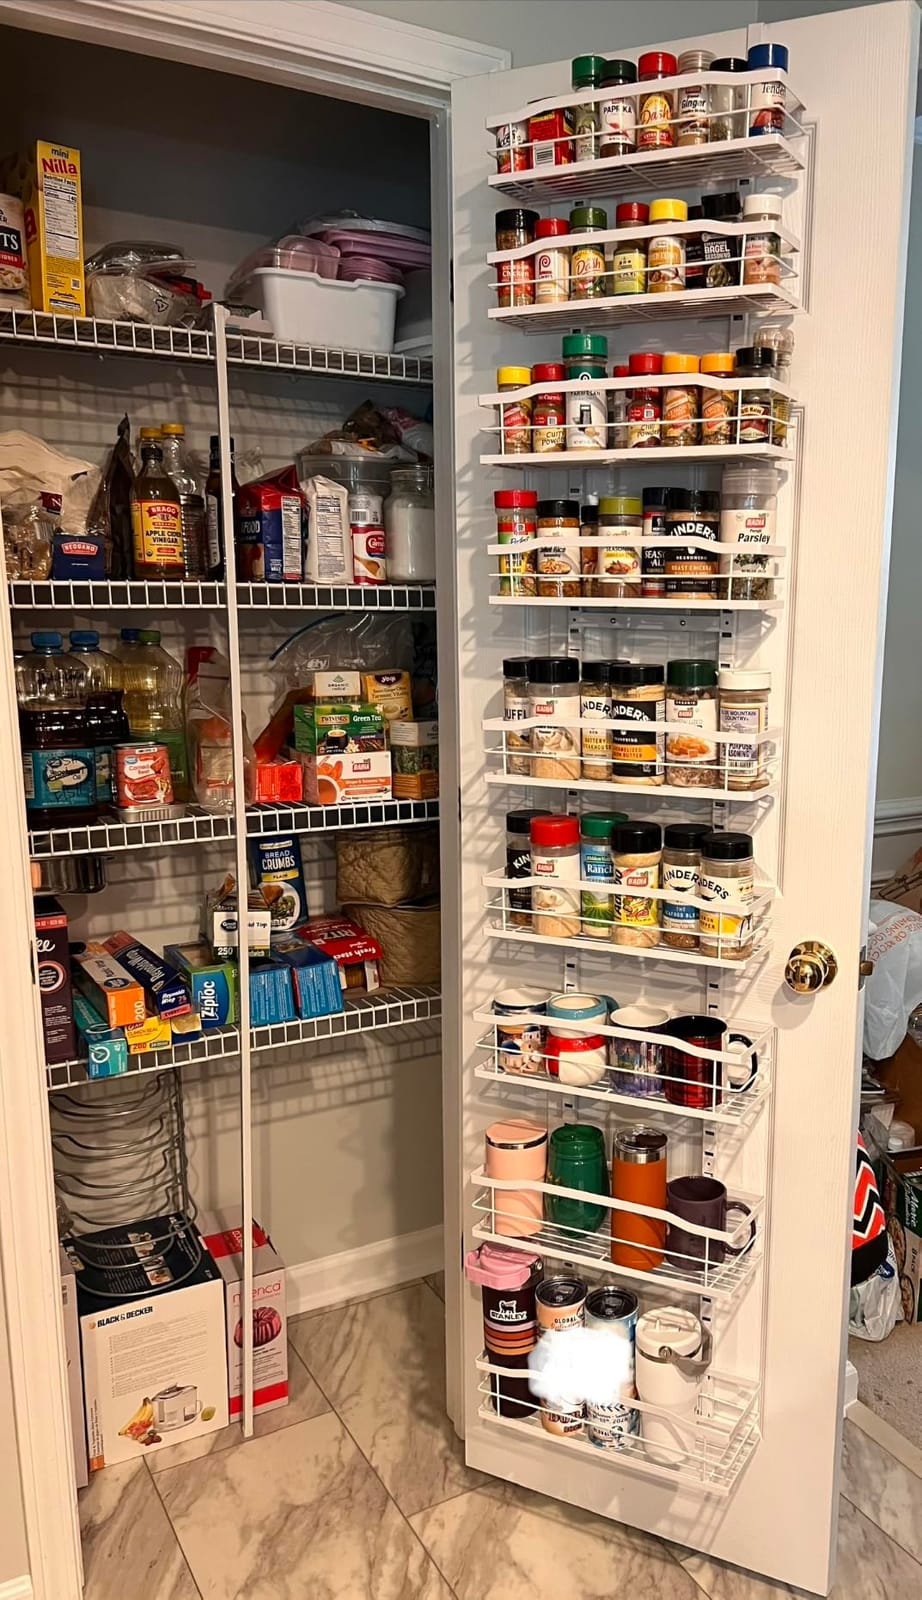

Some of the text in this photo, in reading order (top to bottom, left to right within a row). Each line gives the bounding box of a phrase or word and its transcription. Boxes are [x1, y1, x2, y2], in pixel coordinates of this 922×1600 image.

[603, 104, 633, 114] PAPRKA
[681, 98, 706, 109] Ginger
[641, 109, 672, 125] Dash
[51, 148, 69, 159] mini
[42, 158, 78, 174] Nilla
[704, 244, 730, 254] BAGEL
[576, 257, 601, 275] Dash
[502, 270, 529, 278] Chcken
[151, 505, 177, 515] BRAGG
[737, 532, 771, 544] Parsley
[265, 850, 290, 859] BREAD
[261, 855, 295, 870] CRUMBS
[320, 929, 357, 940] RITZ
[217, 946, 234, 956] 250
[354, 947, 377, 957] fresh
[201, 980, 219, 1019] Ziploc
[134, 1000, 146, 1021] 200
[97, 1315, 120, 1328] BLACK
[126, 1306, 153, 1320] DECKER
[489, 1310, 528, 1321] STANLEY
[554, 1316, 577, 1324] GLOBAL
